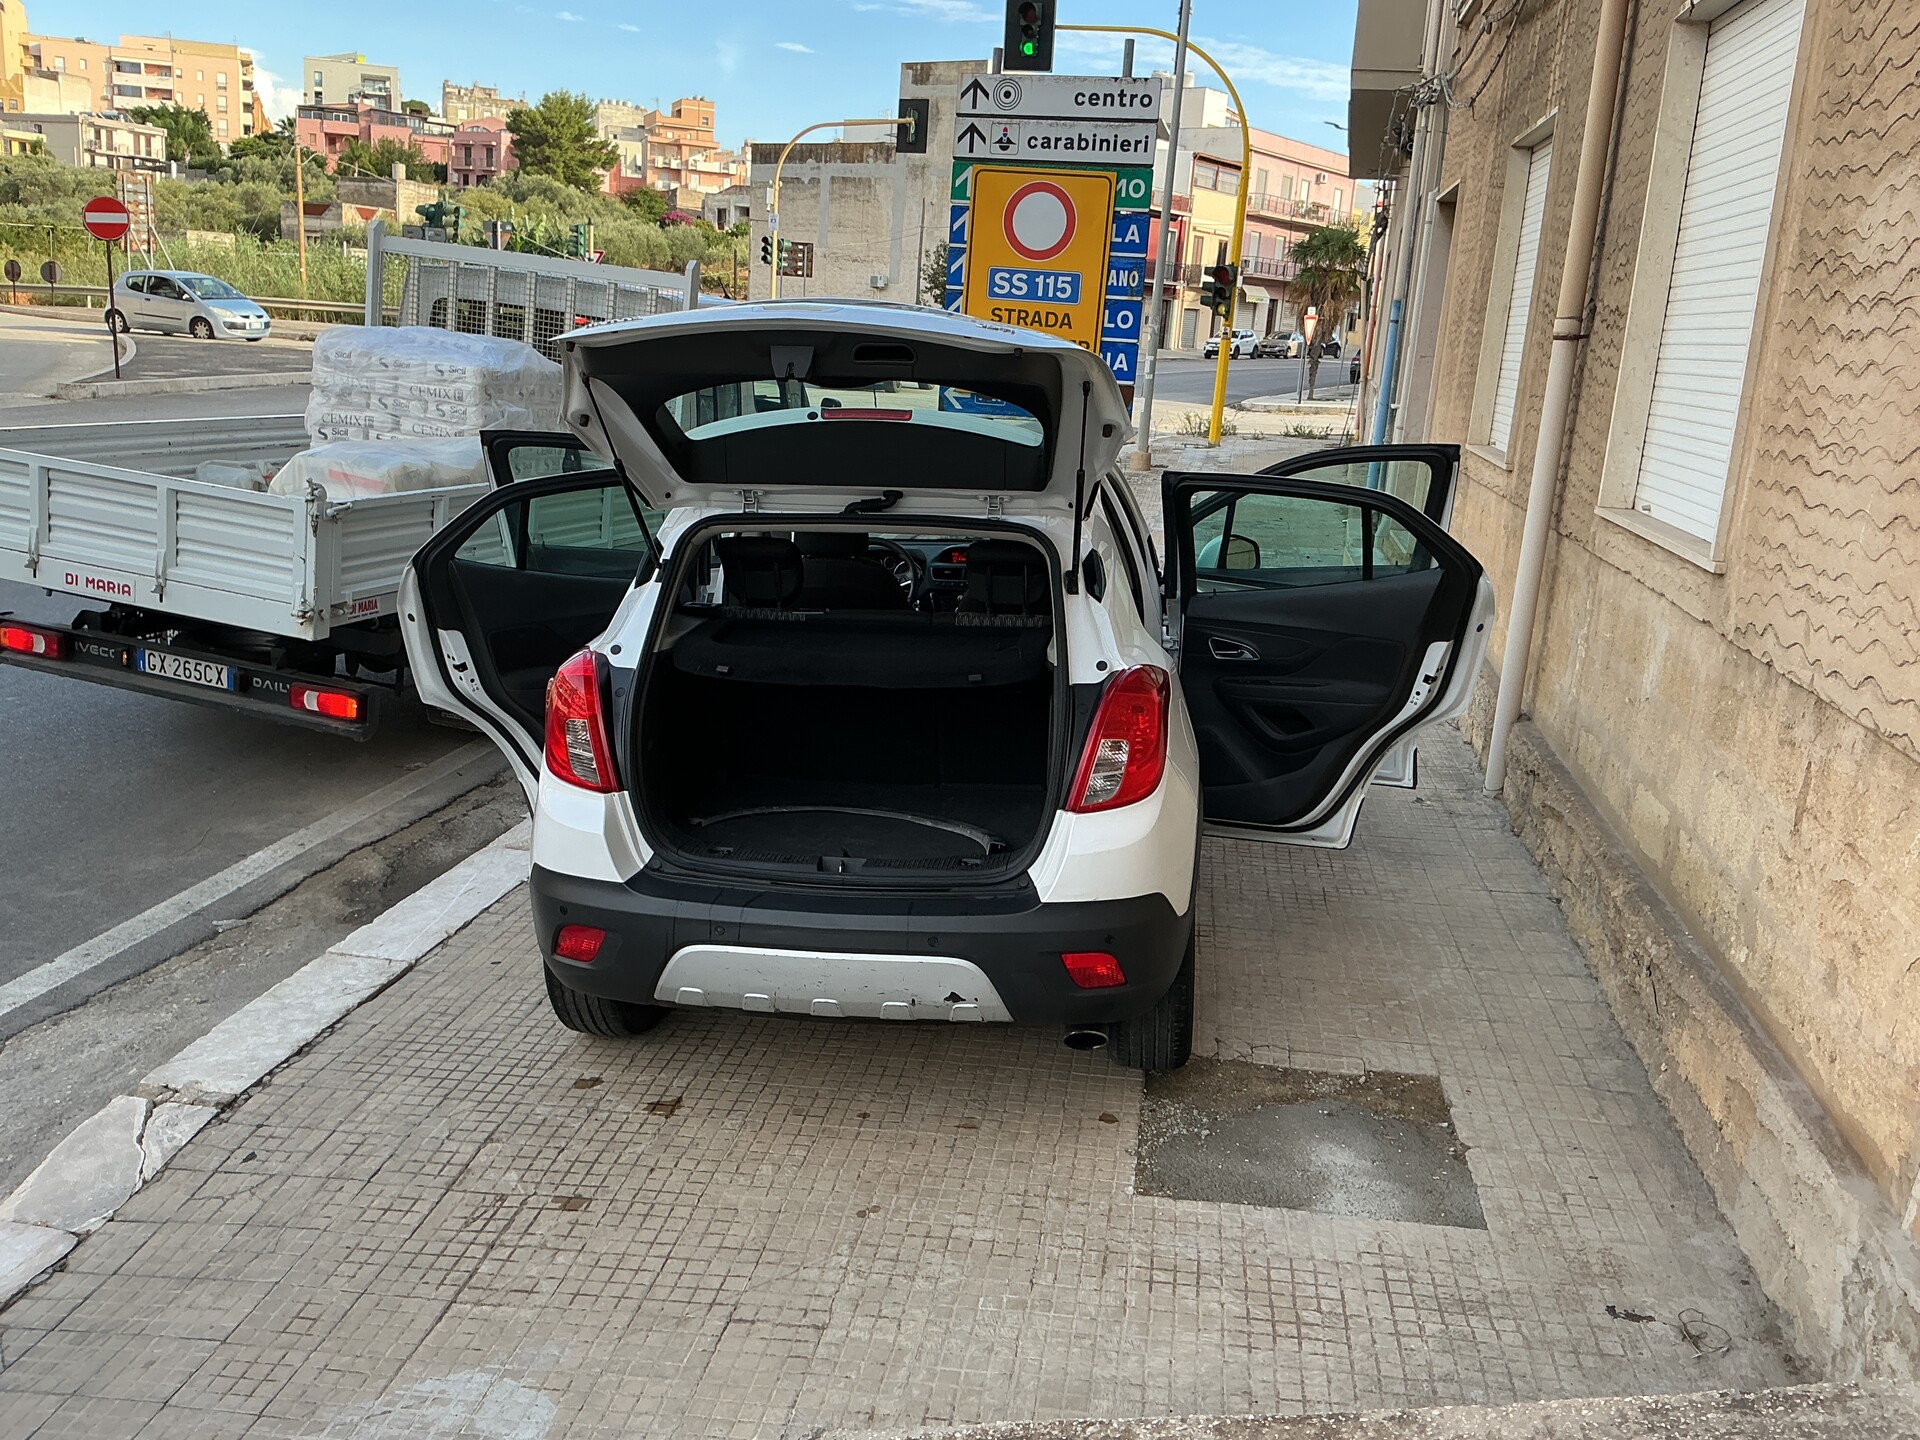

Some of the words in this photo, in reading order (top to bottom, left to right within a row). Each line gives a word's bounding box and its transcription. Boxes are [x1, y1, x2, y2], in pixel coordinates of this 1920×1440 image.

[1074, 89, 1153, 108] centro
[1027, 133, 1149, 153] carabinieri
[993, 272, 1028, 296] SS
[1035, 274, 1072, 299] 115
[991, 307, 1073, 330] STRADA
[321, 412, 362, 427] CEMIX
[331, 427, 349, 437] Sicil
[65, 572, 79, 586] DI
[85, 576, 131, 597] MARIA
